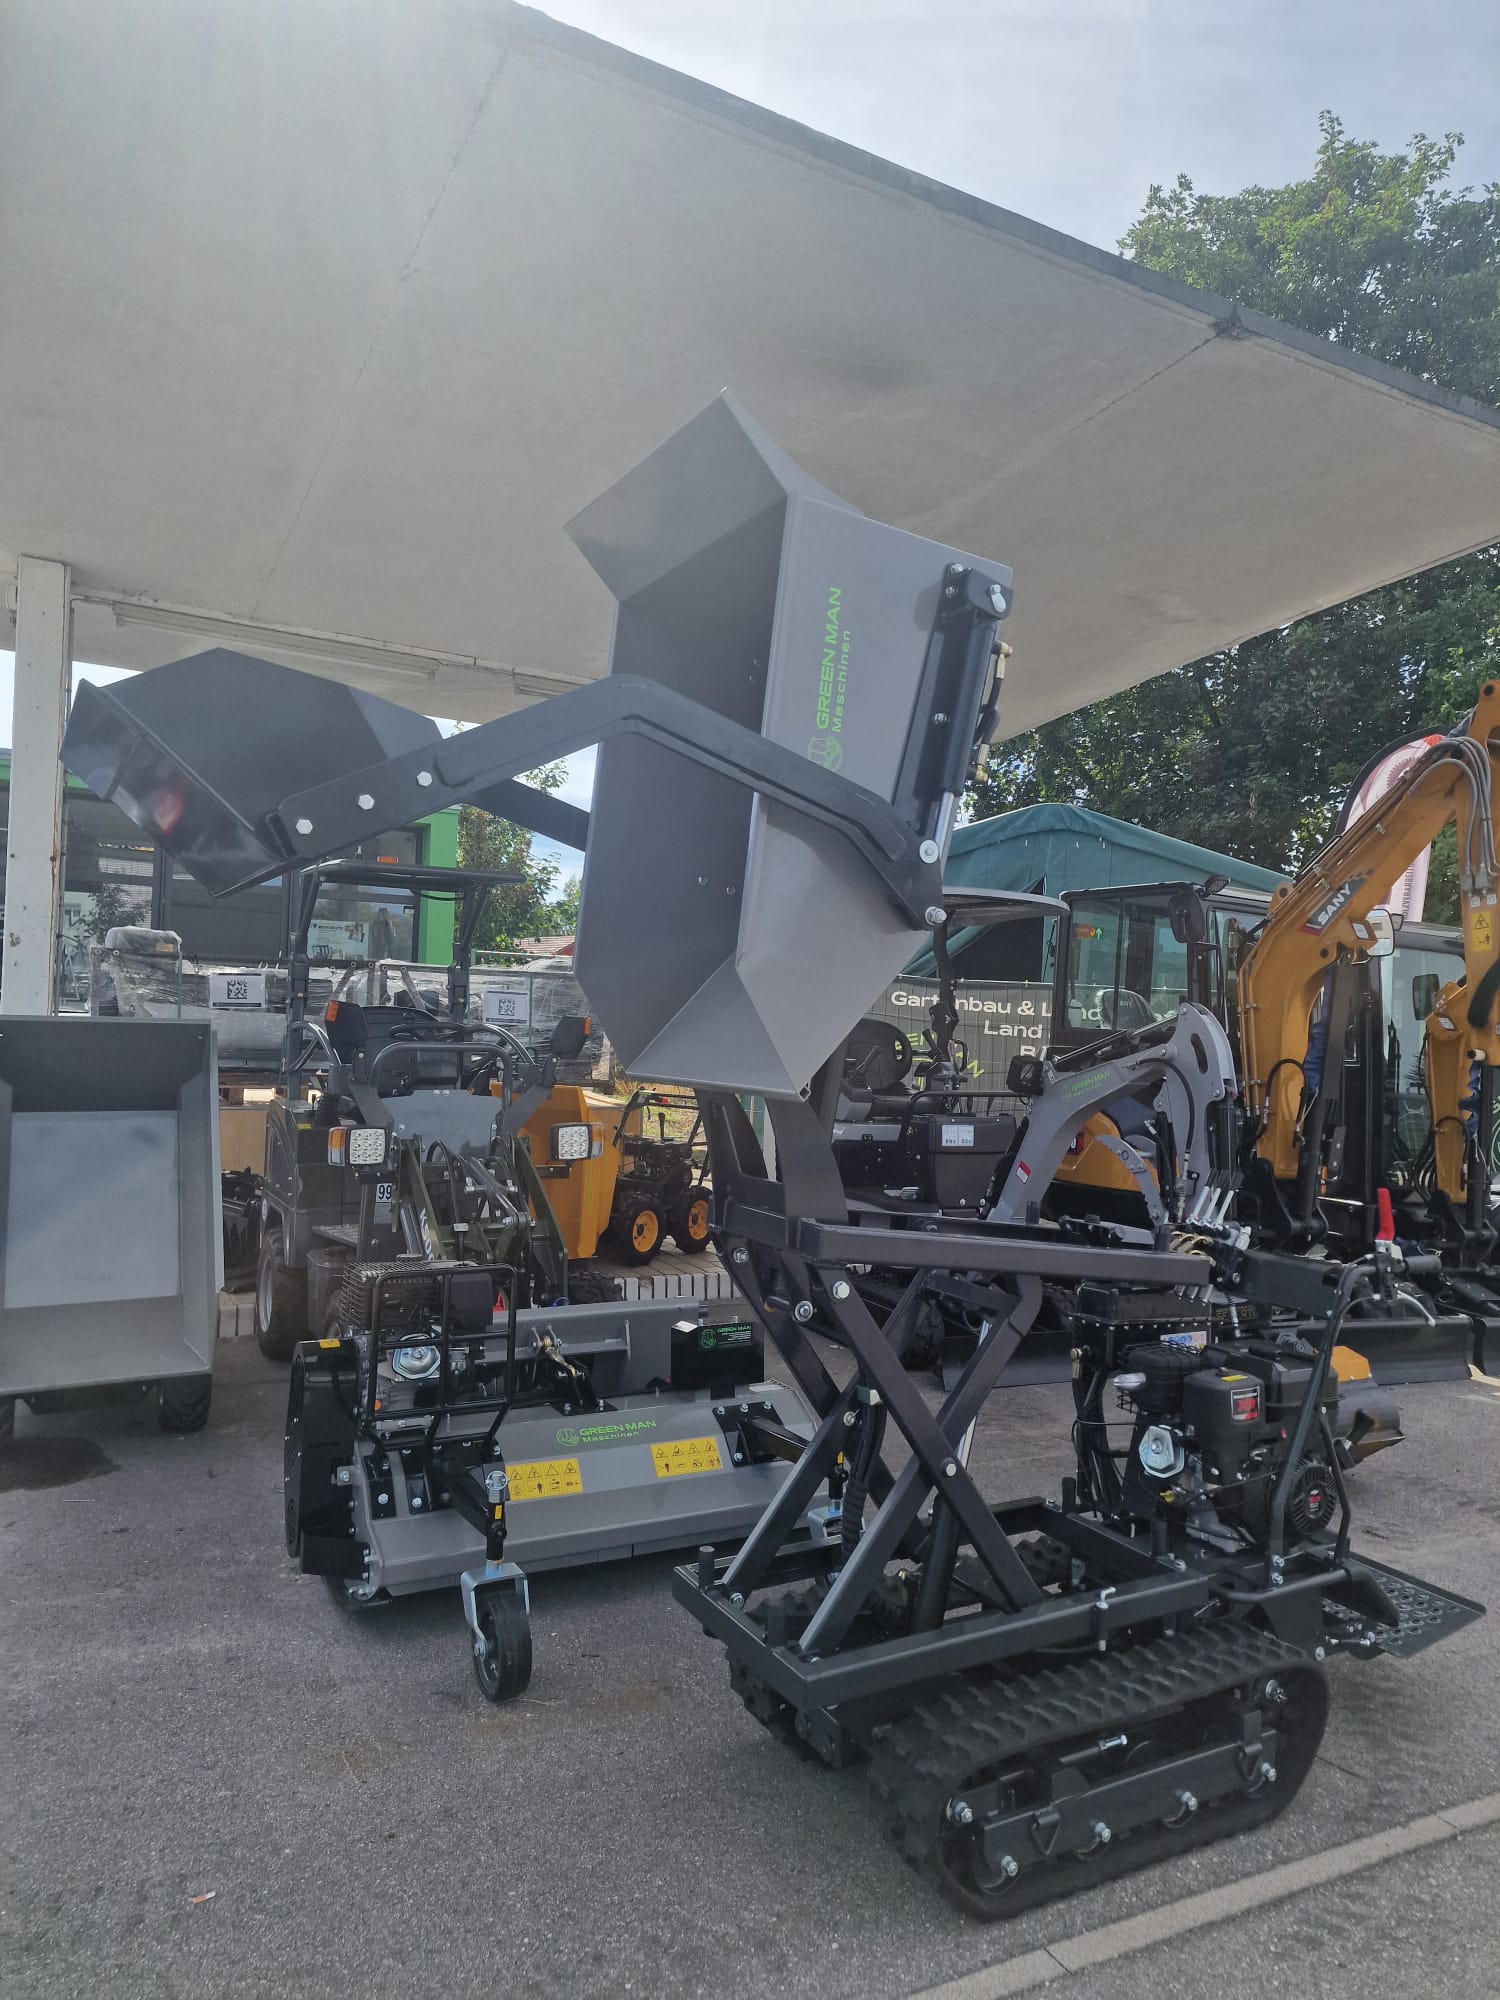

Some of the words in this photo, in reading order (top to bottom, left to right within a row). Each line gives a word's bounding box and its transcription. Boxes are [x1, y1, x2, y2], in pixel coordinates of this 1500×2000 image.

[824, 586, 843, 645] MAN
[816, 648, 837, 729] GREEN
[832, 630, 851, 732] Maschinen
[1317, 883, 1352, 926] SANY
[891, 991, 1011, 1015] Gartnbau
[1017, 1000, 1036, 1016] &
[984, 1020, 1043, 1039] Land
[580, 1424, 624, 1436] GREEN
[625, 1420, 657, 1431] MAN
[582, 1431, 640, 1443] Maschinen
